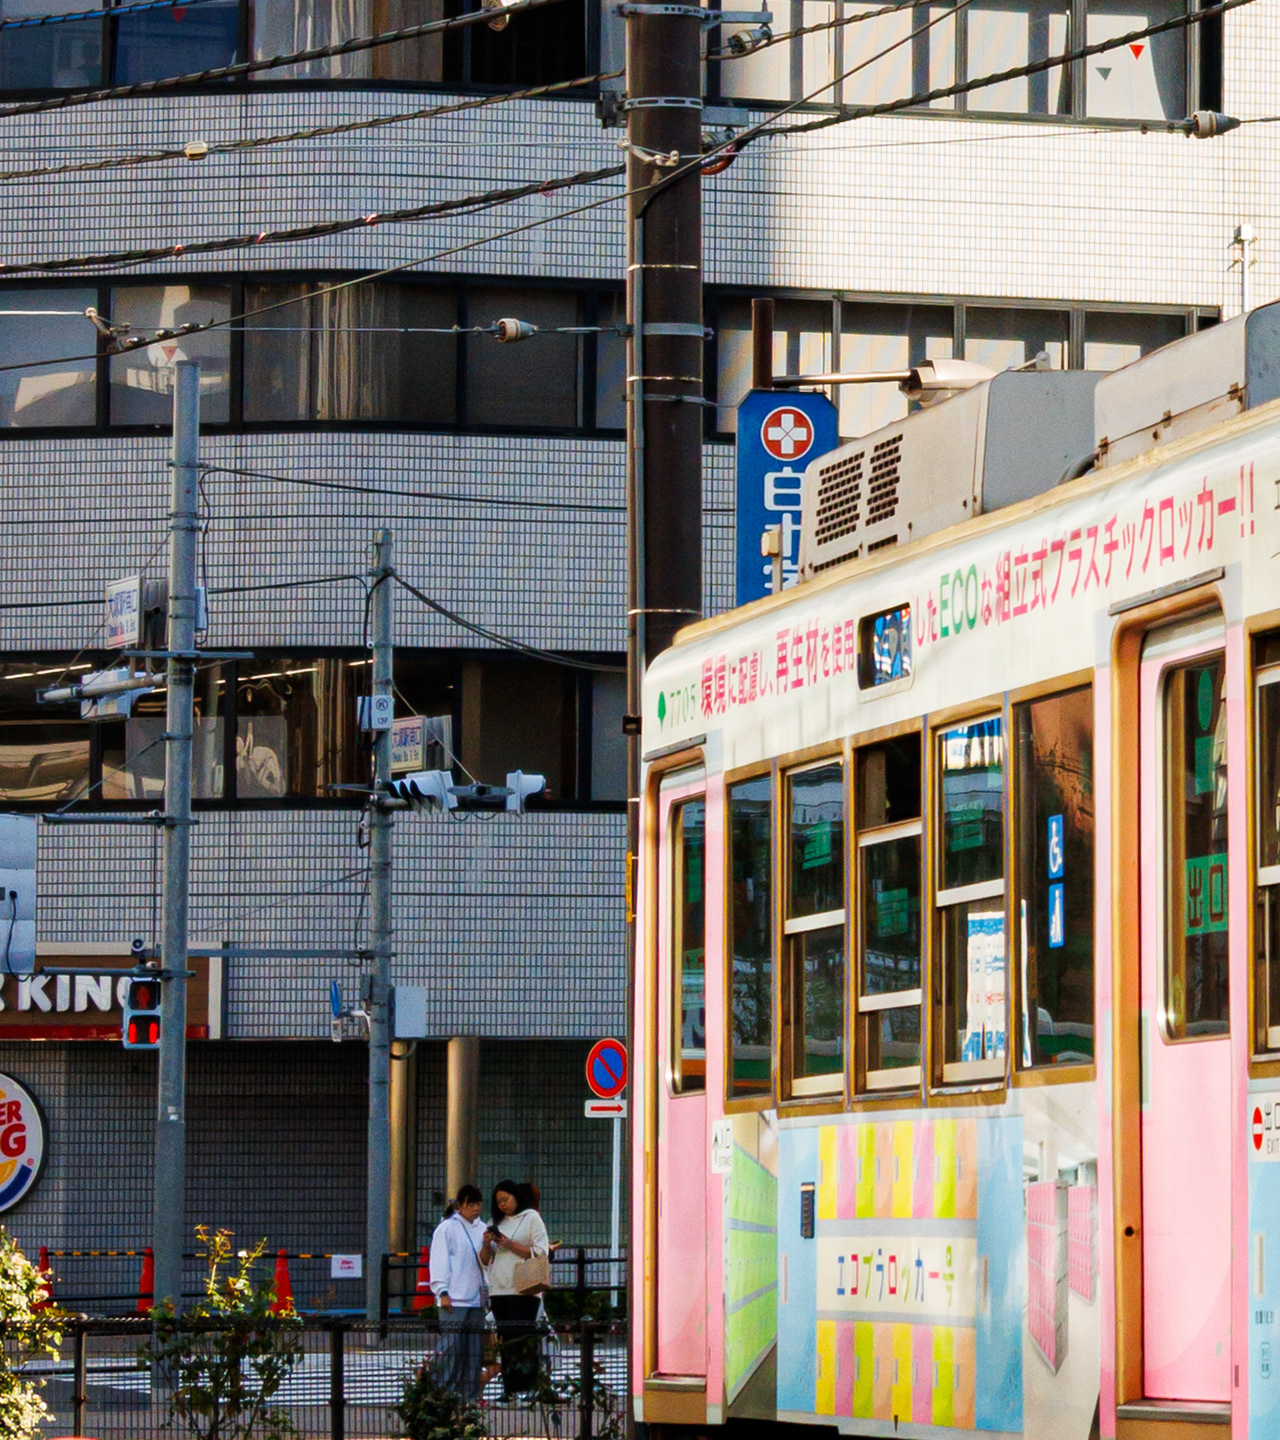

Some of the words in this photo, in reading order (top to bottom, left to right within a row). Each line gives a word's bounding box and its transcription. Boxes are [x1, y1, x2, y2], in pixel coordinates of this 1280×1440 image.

[836, 1245, 954, 1307] エコプラロッカー号
